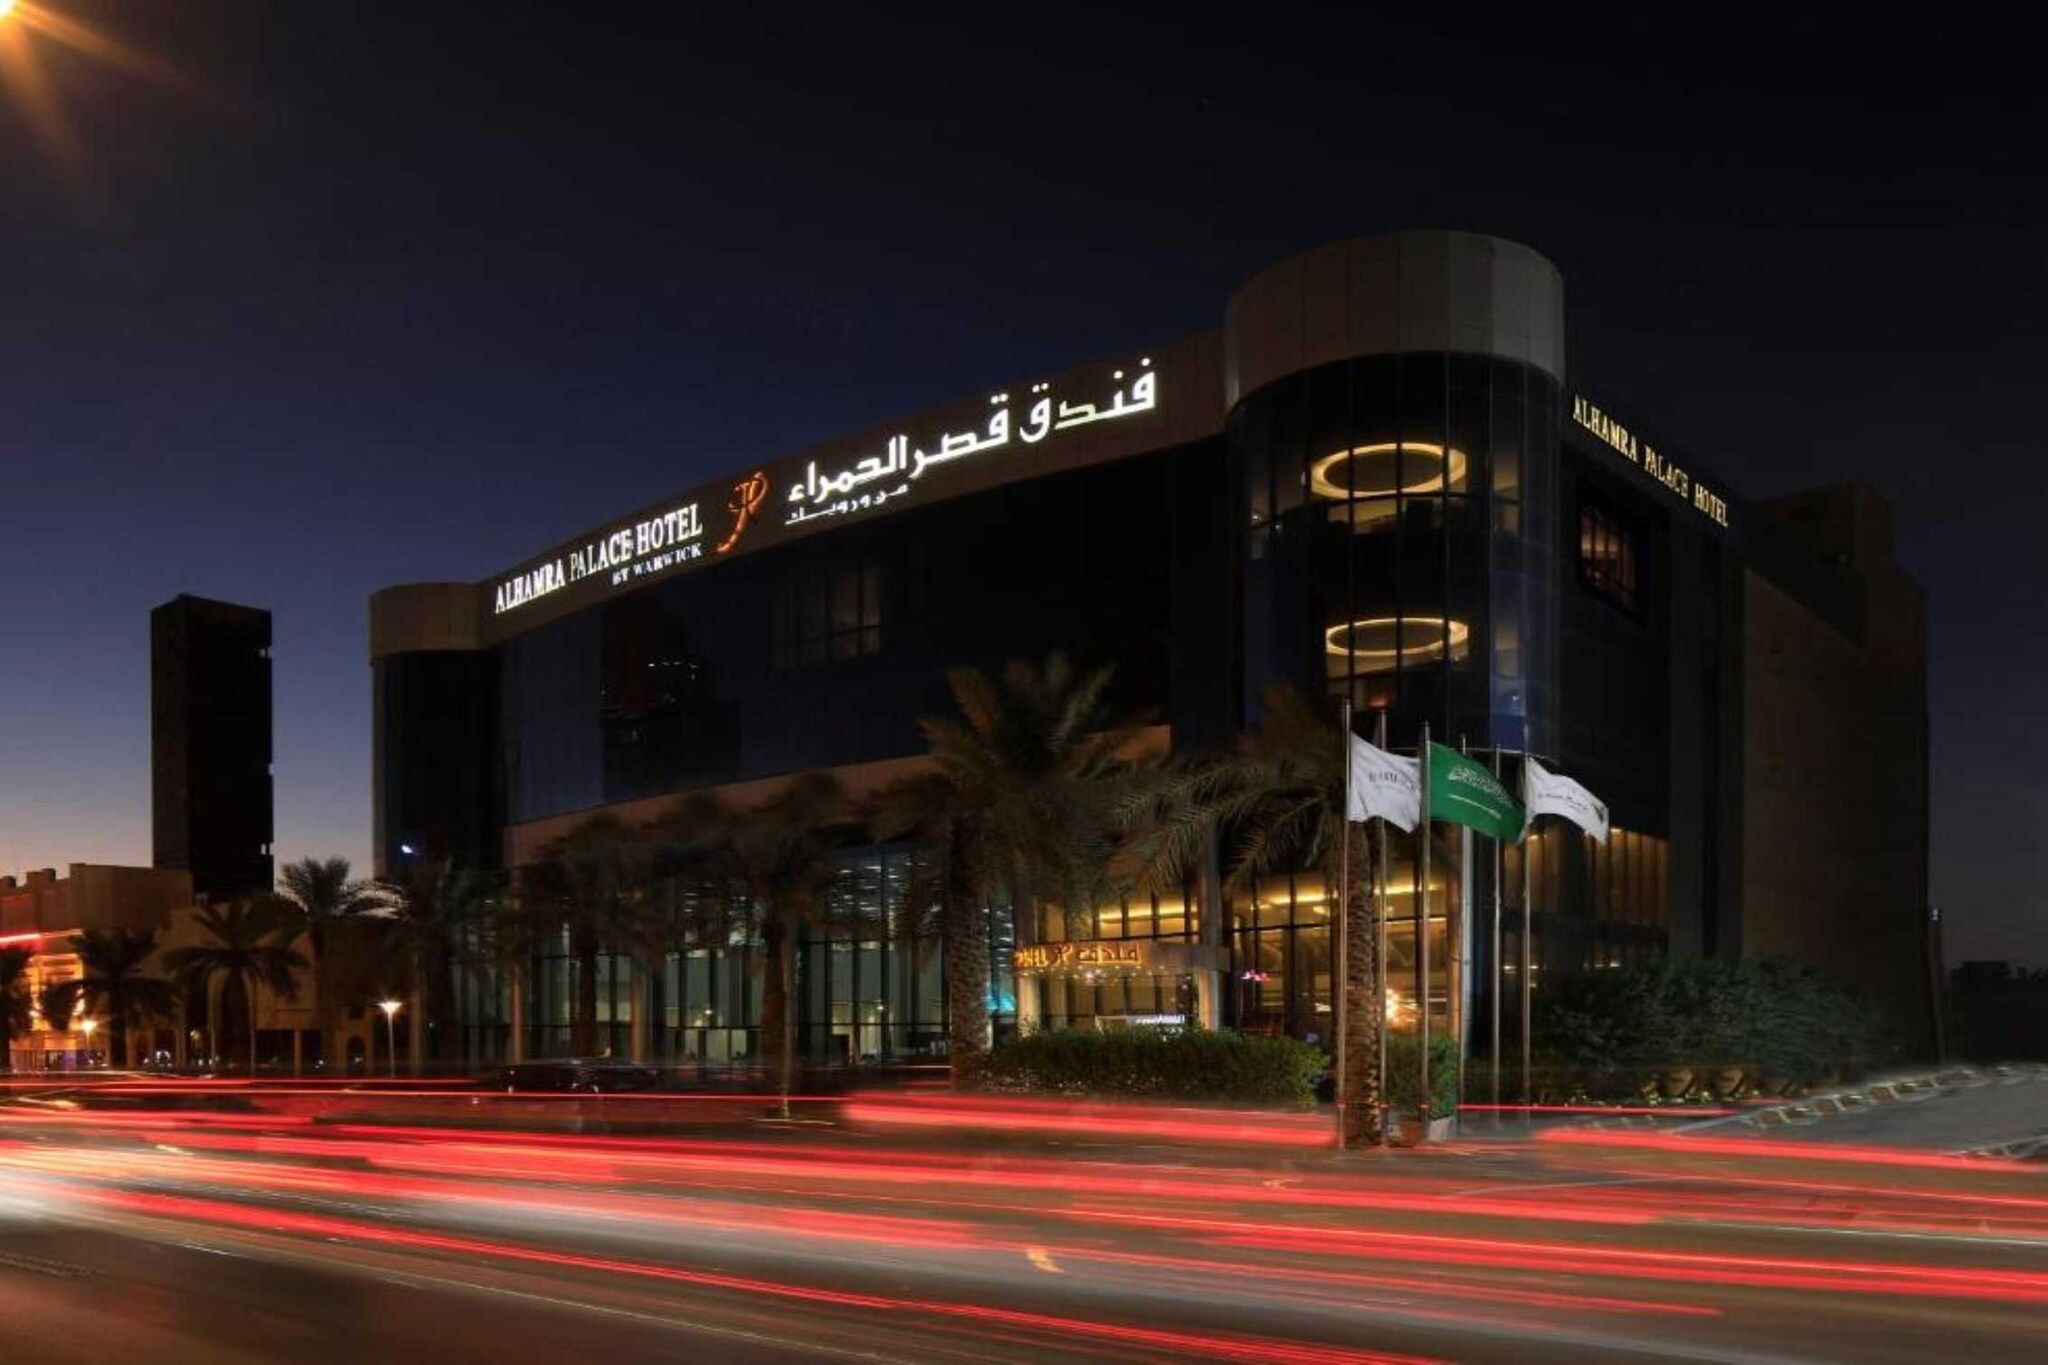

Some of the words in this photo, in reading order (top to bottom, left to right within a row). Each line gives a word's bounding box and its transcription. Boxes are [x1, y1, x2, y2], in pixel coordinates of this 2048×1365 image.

[907, 392, 1010, 479] قصر
[1019, 357, 1156, 443] فندق
[788, 434, 908, 503] الحمراء
[1572, 393, 1638, 463] ALHAMRA
[1643, 445, 1689, 499] PALACE
[1693, 482, 1729, 528] HOTEL
[495, 558, 566, 614] ALHAMRA
[570, 528, 634, 582] PALACE
[635, 503, 703, 556] HOTEL
[612, 567, 630, 586] BY
[633, 542, 703, 577] WARWICK
